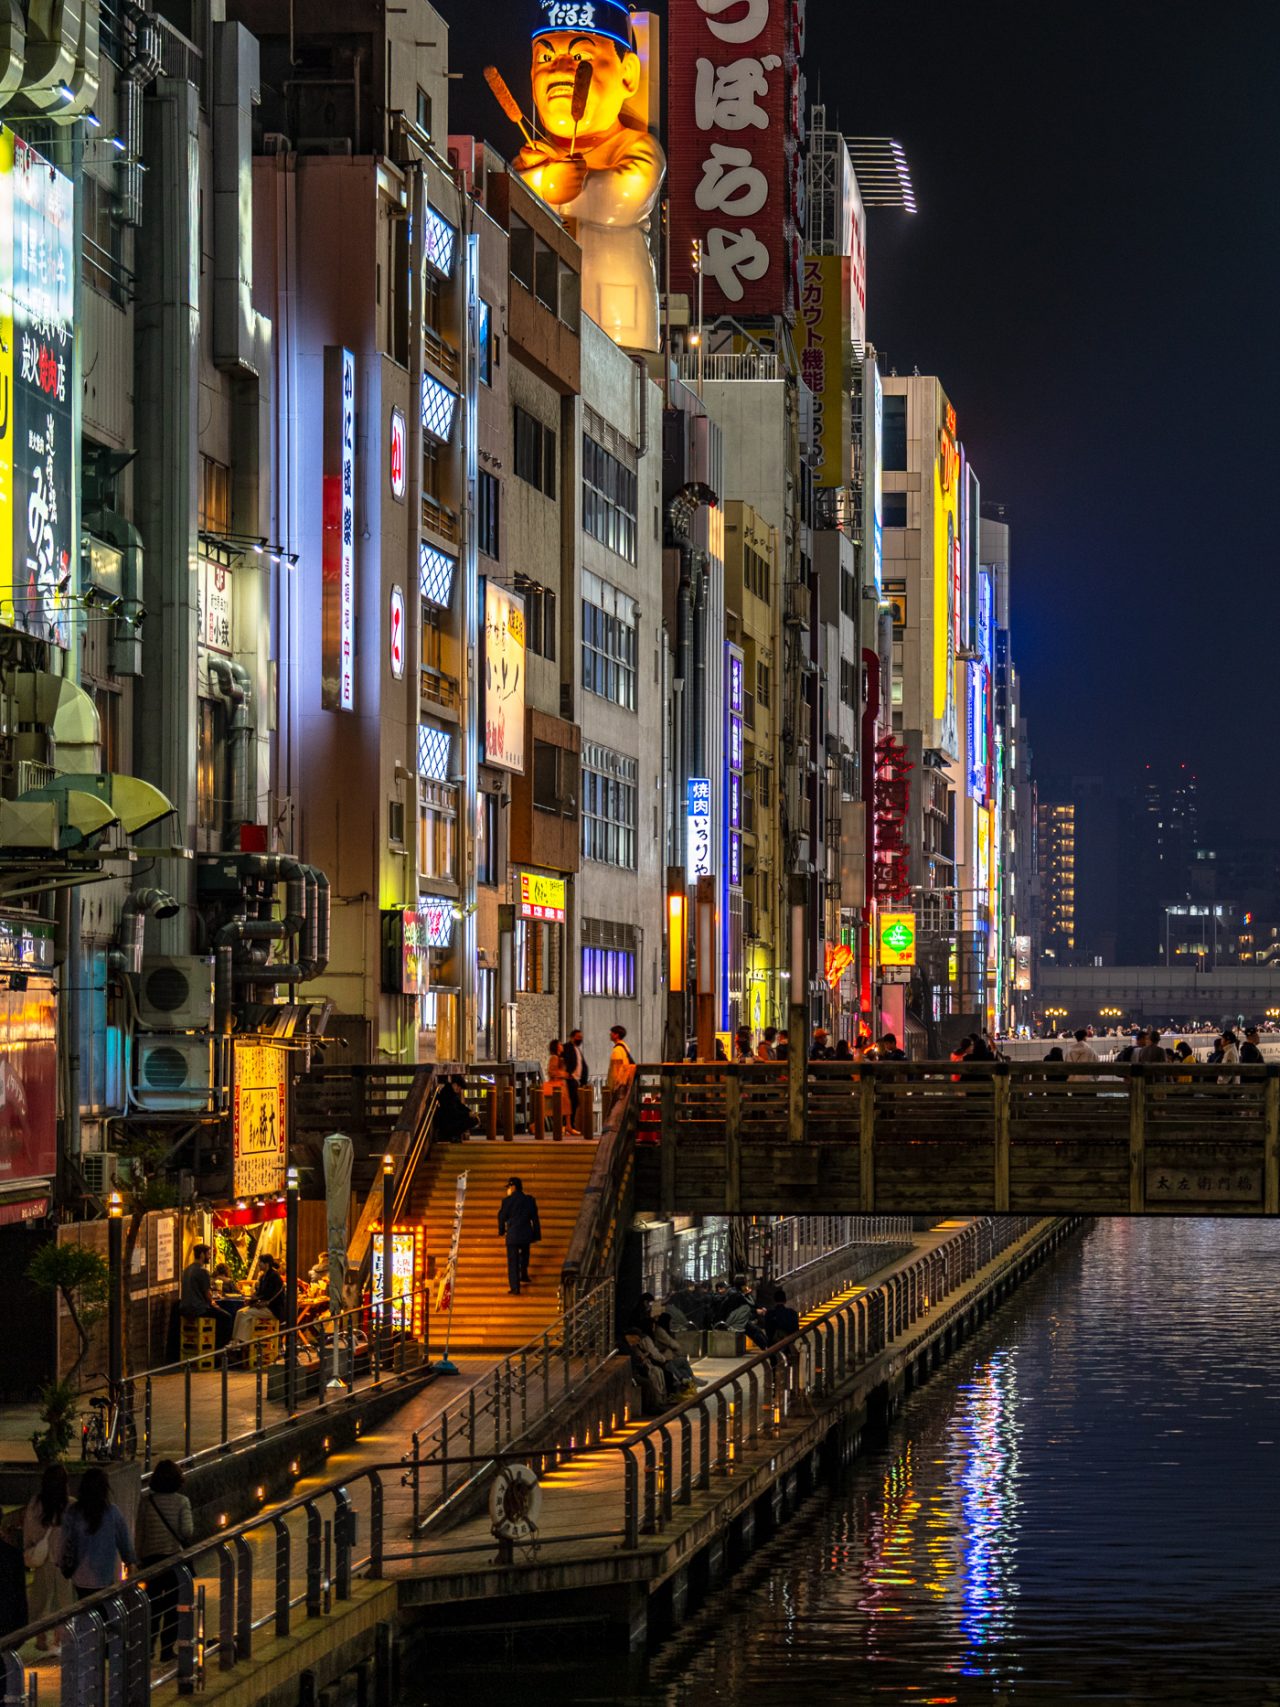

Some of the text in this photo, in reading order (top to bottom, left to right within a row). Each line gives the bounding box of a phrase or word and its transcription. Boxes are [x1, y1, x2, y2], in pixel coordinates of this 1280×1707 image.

[548, 2, 596, 28] だるま
[20, 331, 66, 402] 炭火焼肉店
[693, 782, 710, 876] 焼肉 いろりや
[899, 952, 912, 961] 2F
